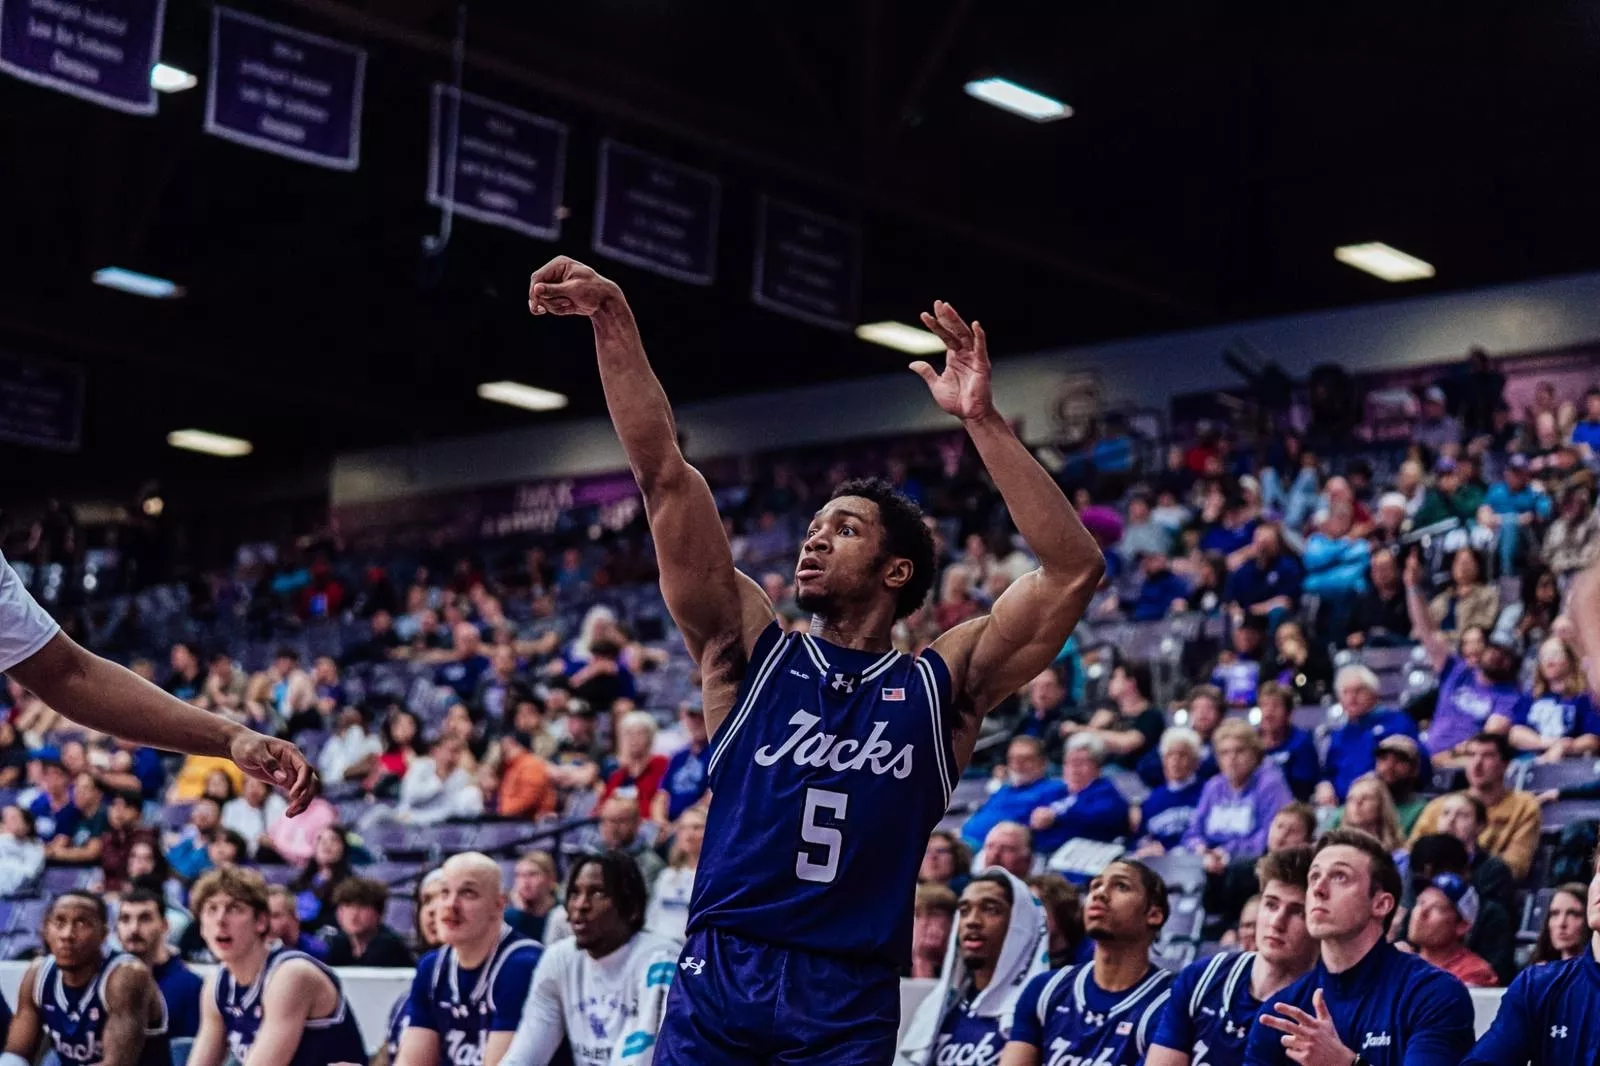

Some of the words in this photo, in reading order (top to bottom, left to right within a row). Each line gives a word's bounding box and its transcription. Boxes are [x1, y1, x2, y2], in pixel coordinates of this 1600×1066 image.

[754, 708, 914, 779] Jacks
[795, 787, 848, 883] 5
[1362, 1031, 1391, 1050] Jacks
